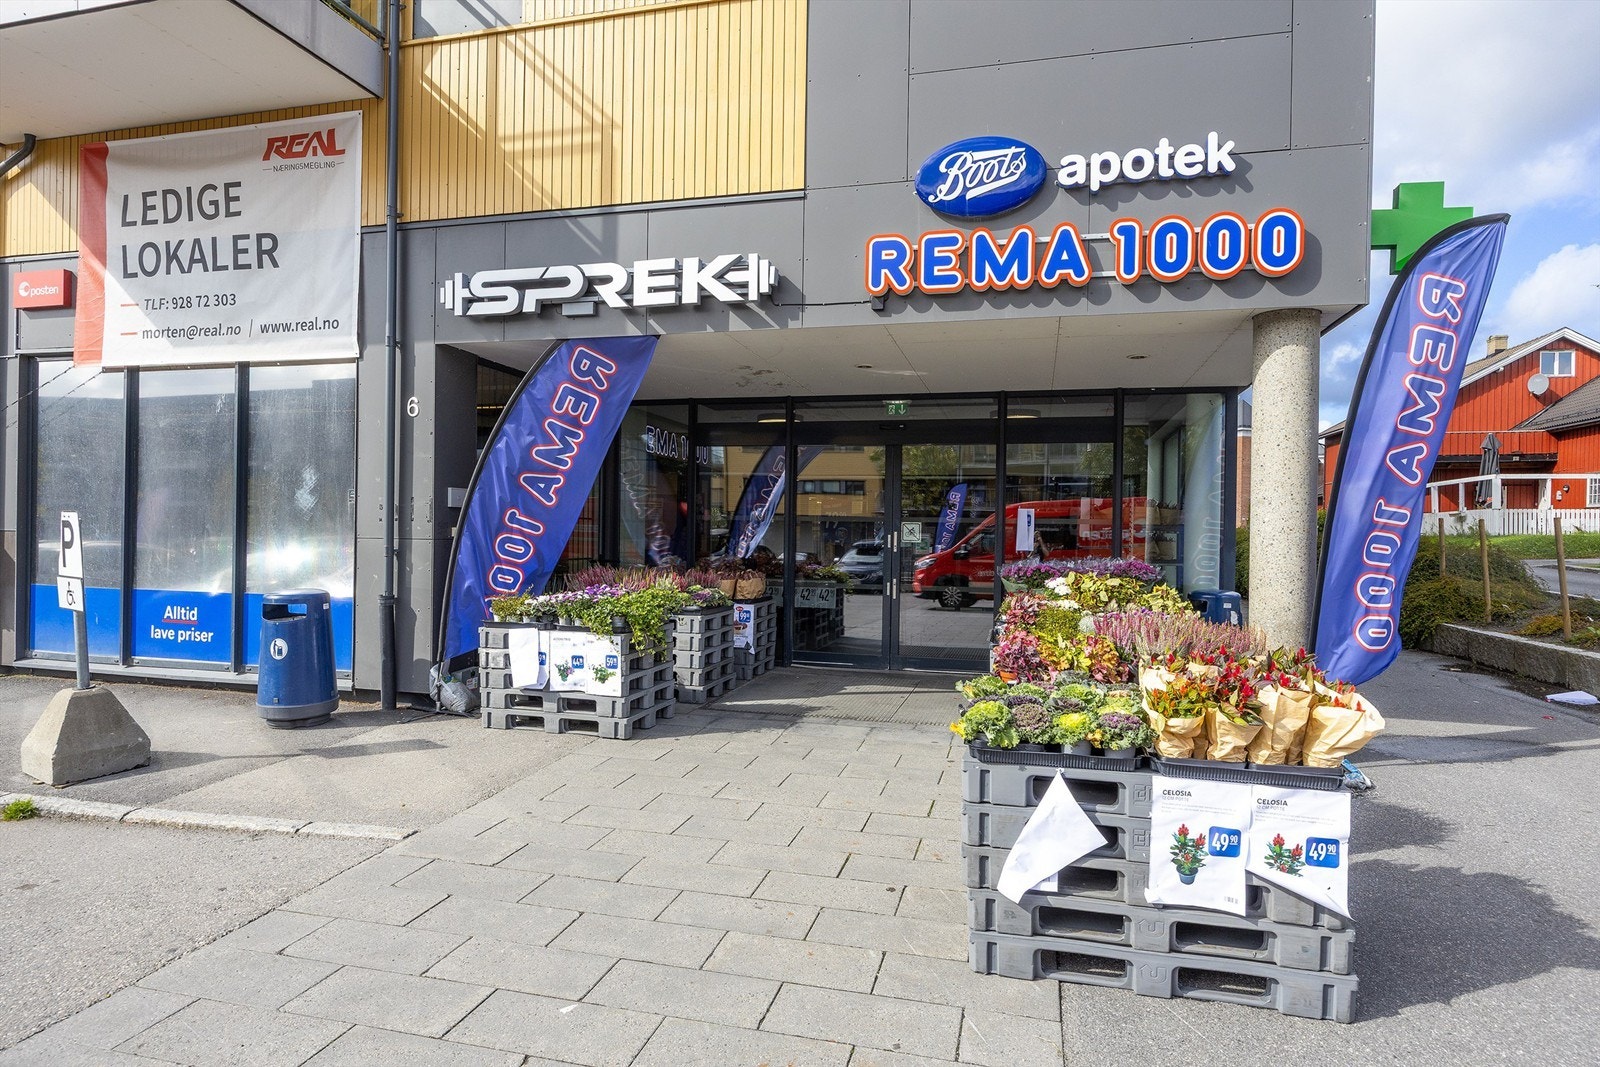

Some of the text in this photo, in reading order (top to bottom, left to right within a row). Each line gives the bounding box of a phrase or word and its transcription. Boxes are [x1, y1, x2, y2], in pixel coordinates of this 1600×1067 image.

[262, 128, 346, 161] REAL
[272, 160, 336, 173] NÆRINGSMEGLING
[927, 131, 1237, 203] Boots apotek
[121, 181, 242, 228] LEDIGE
[121, 232, 280, 279] LOKALER
[865, 207, 1306, 298] REMA 1000
[30, 285, 59, 298] posten
[465, 252, 746, 317] SPREK
[144, 293, 237, 310] TLF: 928 72 303
[142, 316, 340, 340] morten@real.no www.real.no
[406, 396, 419, 418] 6
[61, 519, 75, 568] P
[163, 605, 198, 621] Alltid
[150, 624, 214, 643] lave priser
[1162, 789, 1192, 797] CELOSIA
[1256, 798, 1288, 806] CELOSIA
[1211, 832, 1229, 851] 49
[1308, 842, 1327, 861] 49
